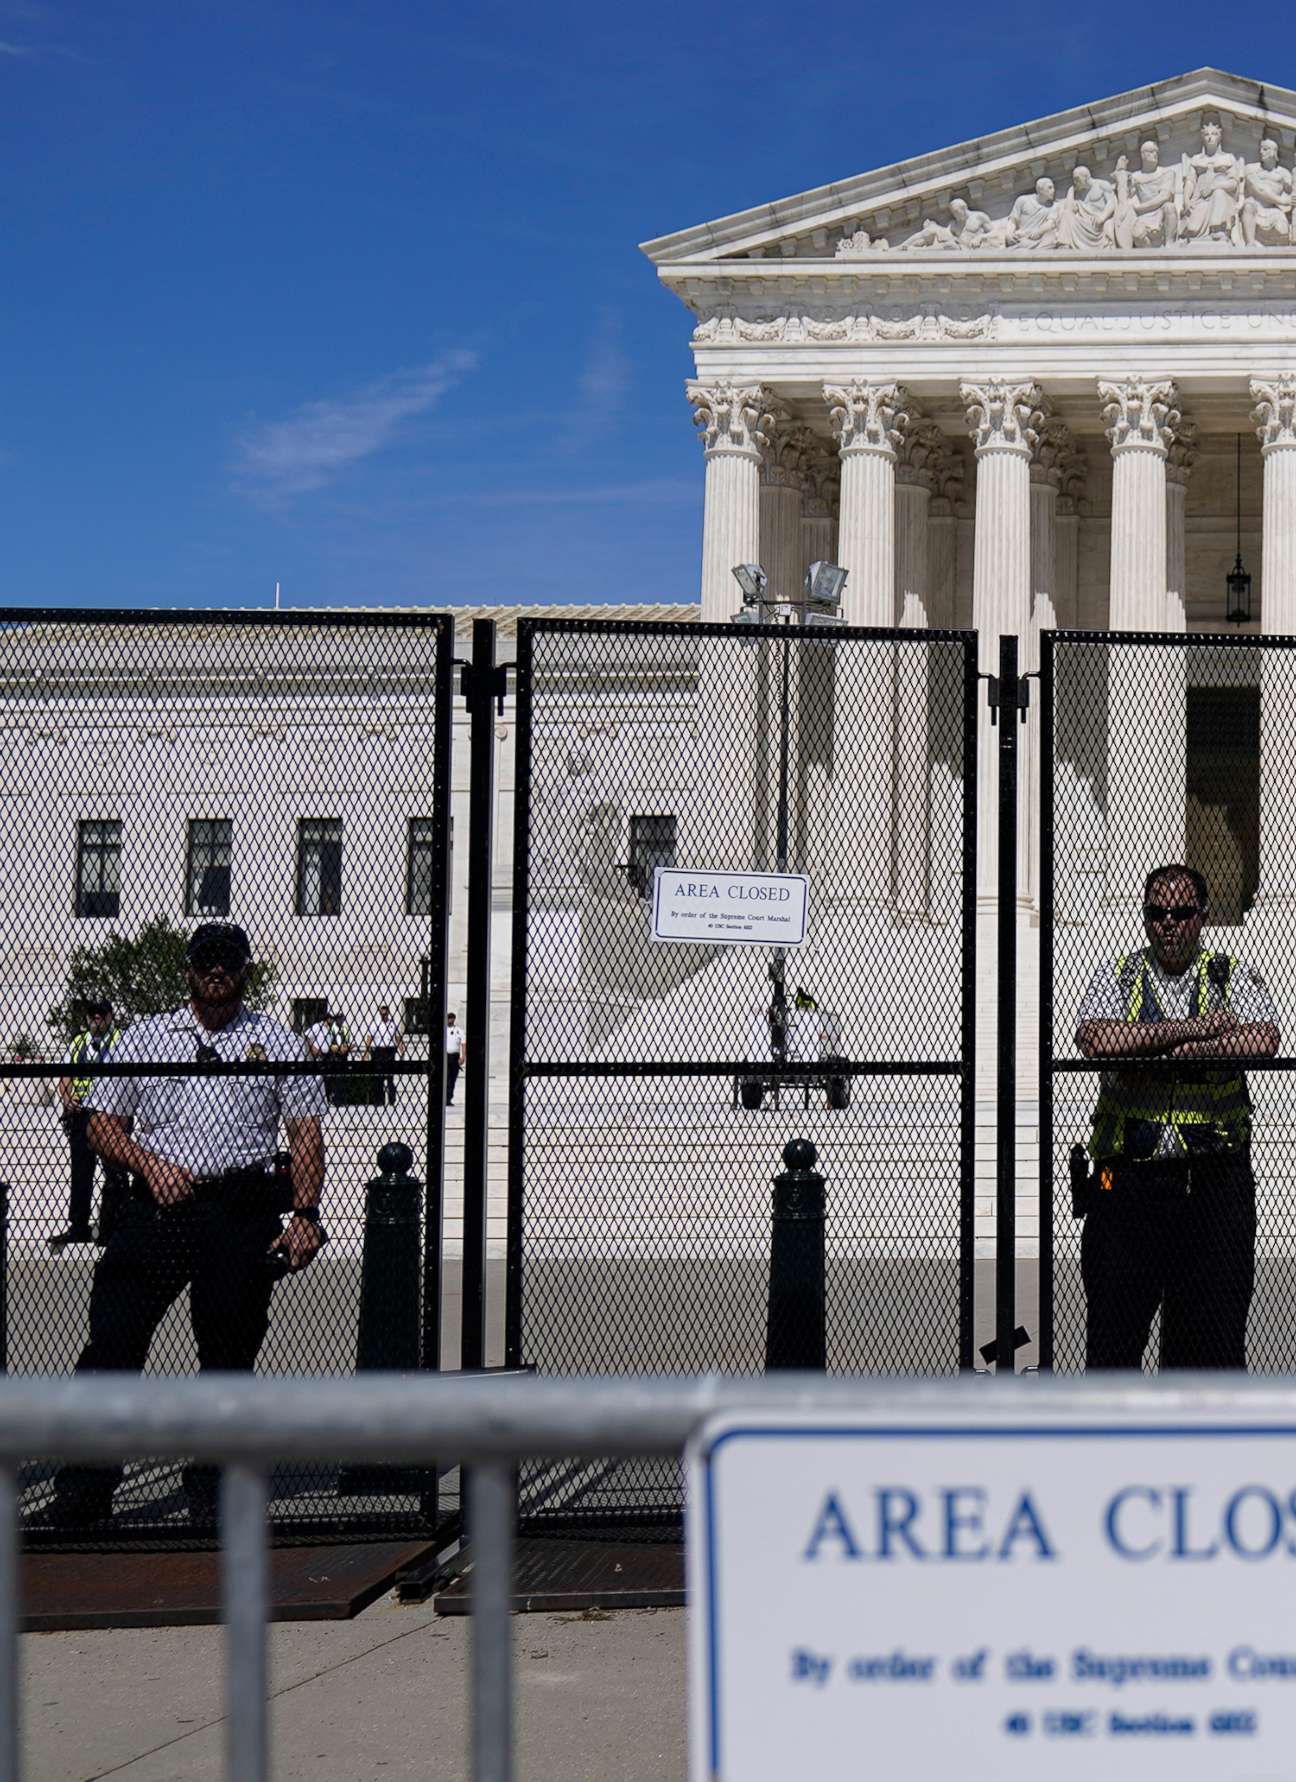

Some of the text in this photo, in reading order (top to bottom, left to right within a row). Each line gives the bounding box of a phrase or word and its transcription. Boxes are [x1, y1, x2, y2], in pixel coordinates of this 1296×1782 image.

[674, 883, 791, 901] AREA CLOSED
[681, 911, 697, 919] order
[720, 913, 745, 921] Supreme
[803, 1485, 1057, 1561] AREA
[791, 1648, 832, 1689] By
[848, 1649, 935, 1679] order
[951, 1648, 989, 1680] of
[1005, 1648, 1055, 1680] the
[1072, 1648, 1211, 1688] Supreme
